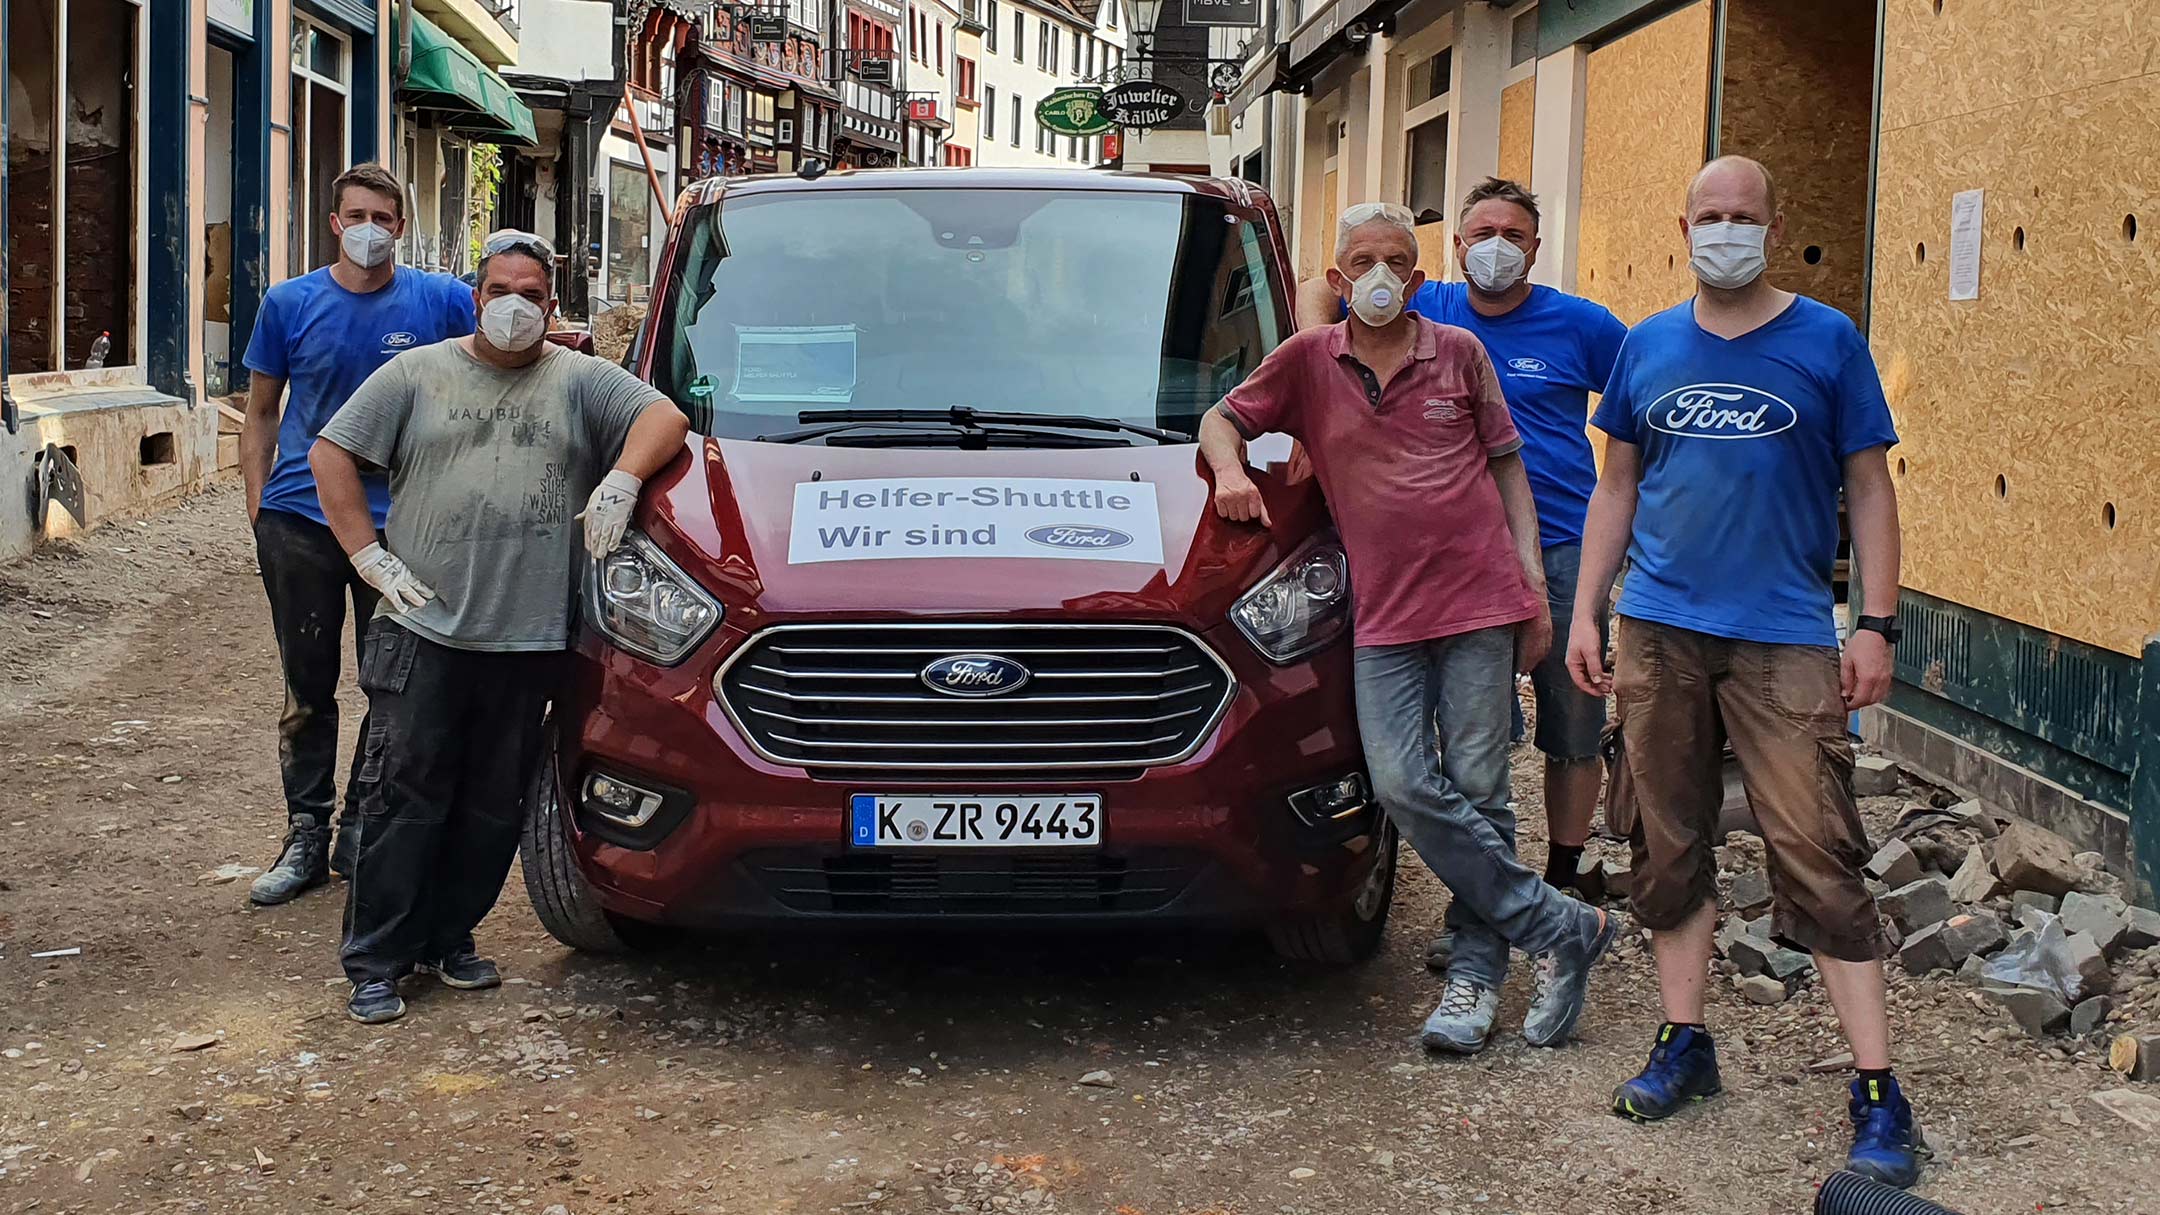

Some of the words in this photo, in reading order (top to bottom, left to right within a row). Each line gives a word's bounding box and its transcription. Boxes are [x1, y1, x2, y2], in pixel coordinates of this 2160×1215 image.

[1103, 88, 1178, 112] Juwelier
[1111, 107, 1170, 125] Kälble
[1514, 358, 1541, 370] Ford
[448, 406, 522, 422] MALIBU
[1665, 390, 1770, 432] Ford
[818, 486, 1132, 511] Helfer-Shuttle
[818, 526, 892, 549] Wir
[904, 524, 997, 547] sind
[1045, 526, 1110, 548] Ford
[945, 660, 1004, 686] Ford
[859, 826, 868, 838] D
[878, 802, 903, 840] K
[932, 802, 984, 841] ZR
[994, 802, 1095, 841] 9443
